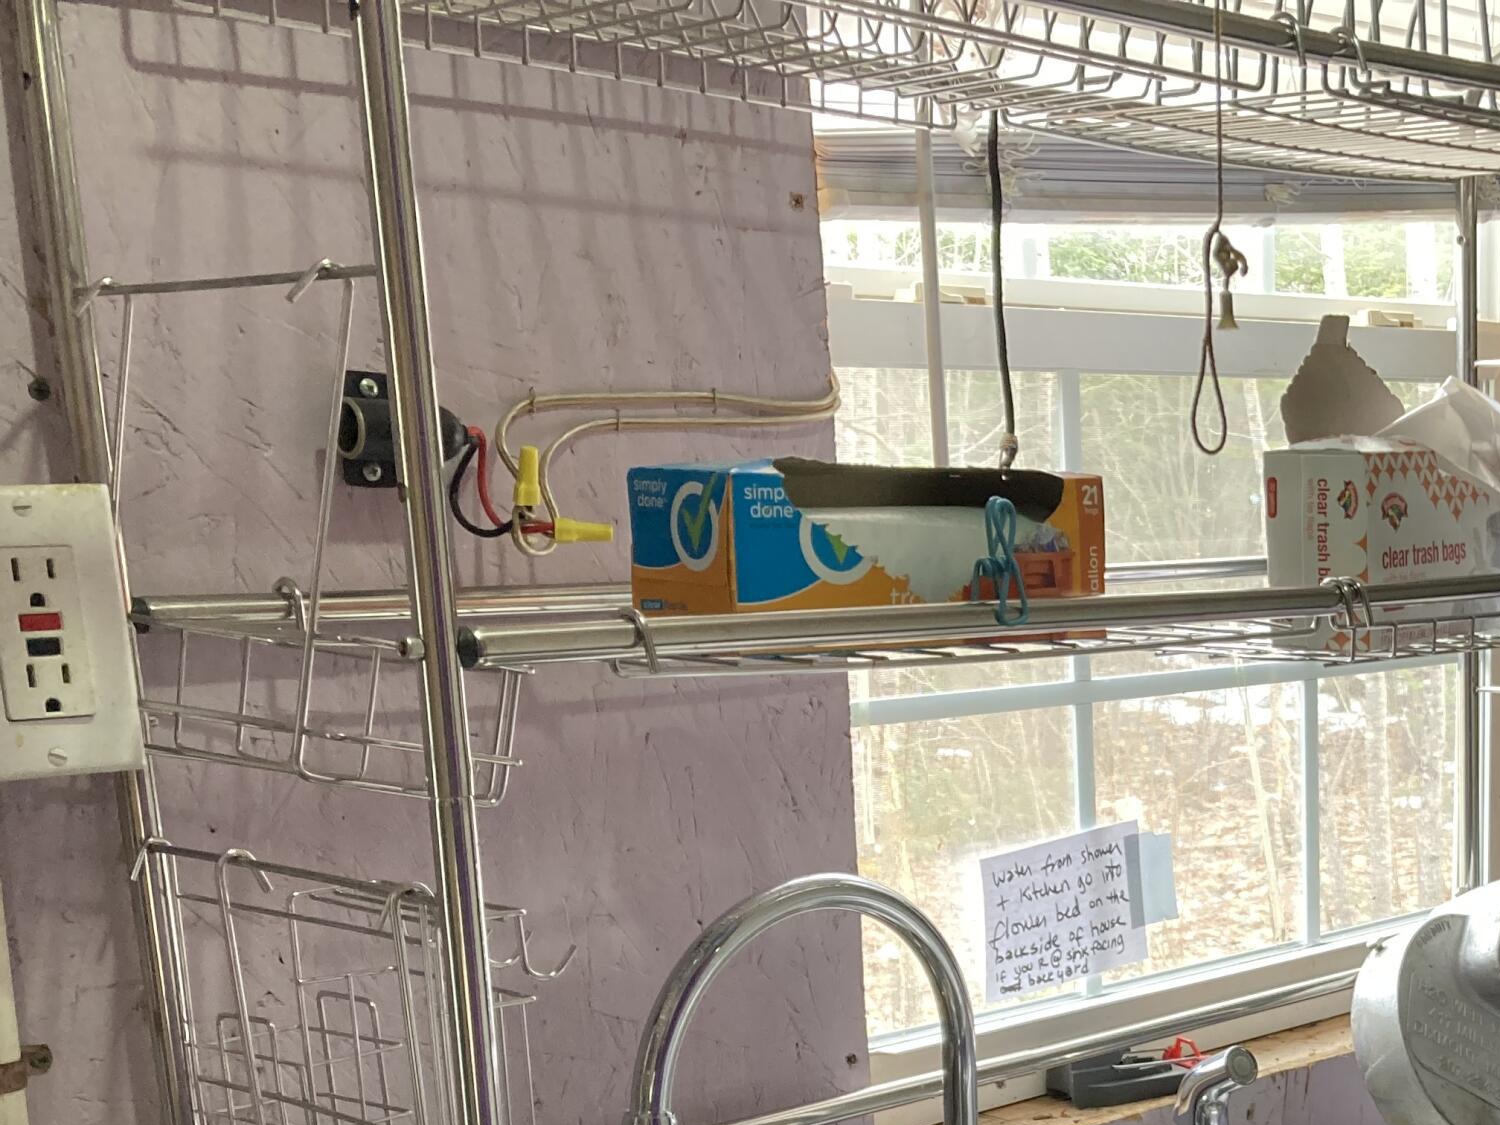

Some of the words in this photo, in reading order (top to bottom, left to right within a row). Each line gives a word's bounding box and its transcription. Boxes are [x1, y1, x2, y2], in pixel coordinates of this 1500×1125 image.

[744, 484, 789, 502] simp
[1082, 485, 1098, 505] 21
[1317, 479, 1330, 517] clear
[750, 502, 794, 518] done
[1317, 523, 1330, 562] trash
[1382, 546, 1409, 569] clear
[1413, 541, 1439, 565] trash
[1442, 539, 1466, 564] bags
[1088, 546, 1098, 594] allon
[1041, 853, 1072, 877] from
[1078, 872, 1093, 895] go
[1102, 859, 1122, 884] into
[1055, 896, 1081, 922] bed
[1089, 897, 1103, 909] on
[1106, 889, 1131, 903] the
[1069, 926, 1084, 944] of
[1090, 915, 1127, 938] house
[1014, 963, 1033, 980] you
[1051, 948, 1062, 968] @
